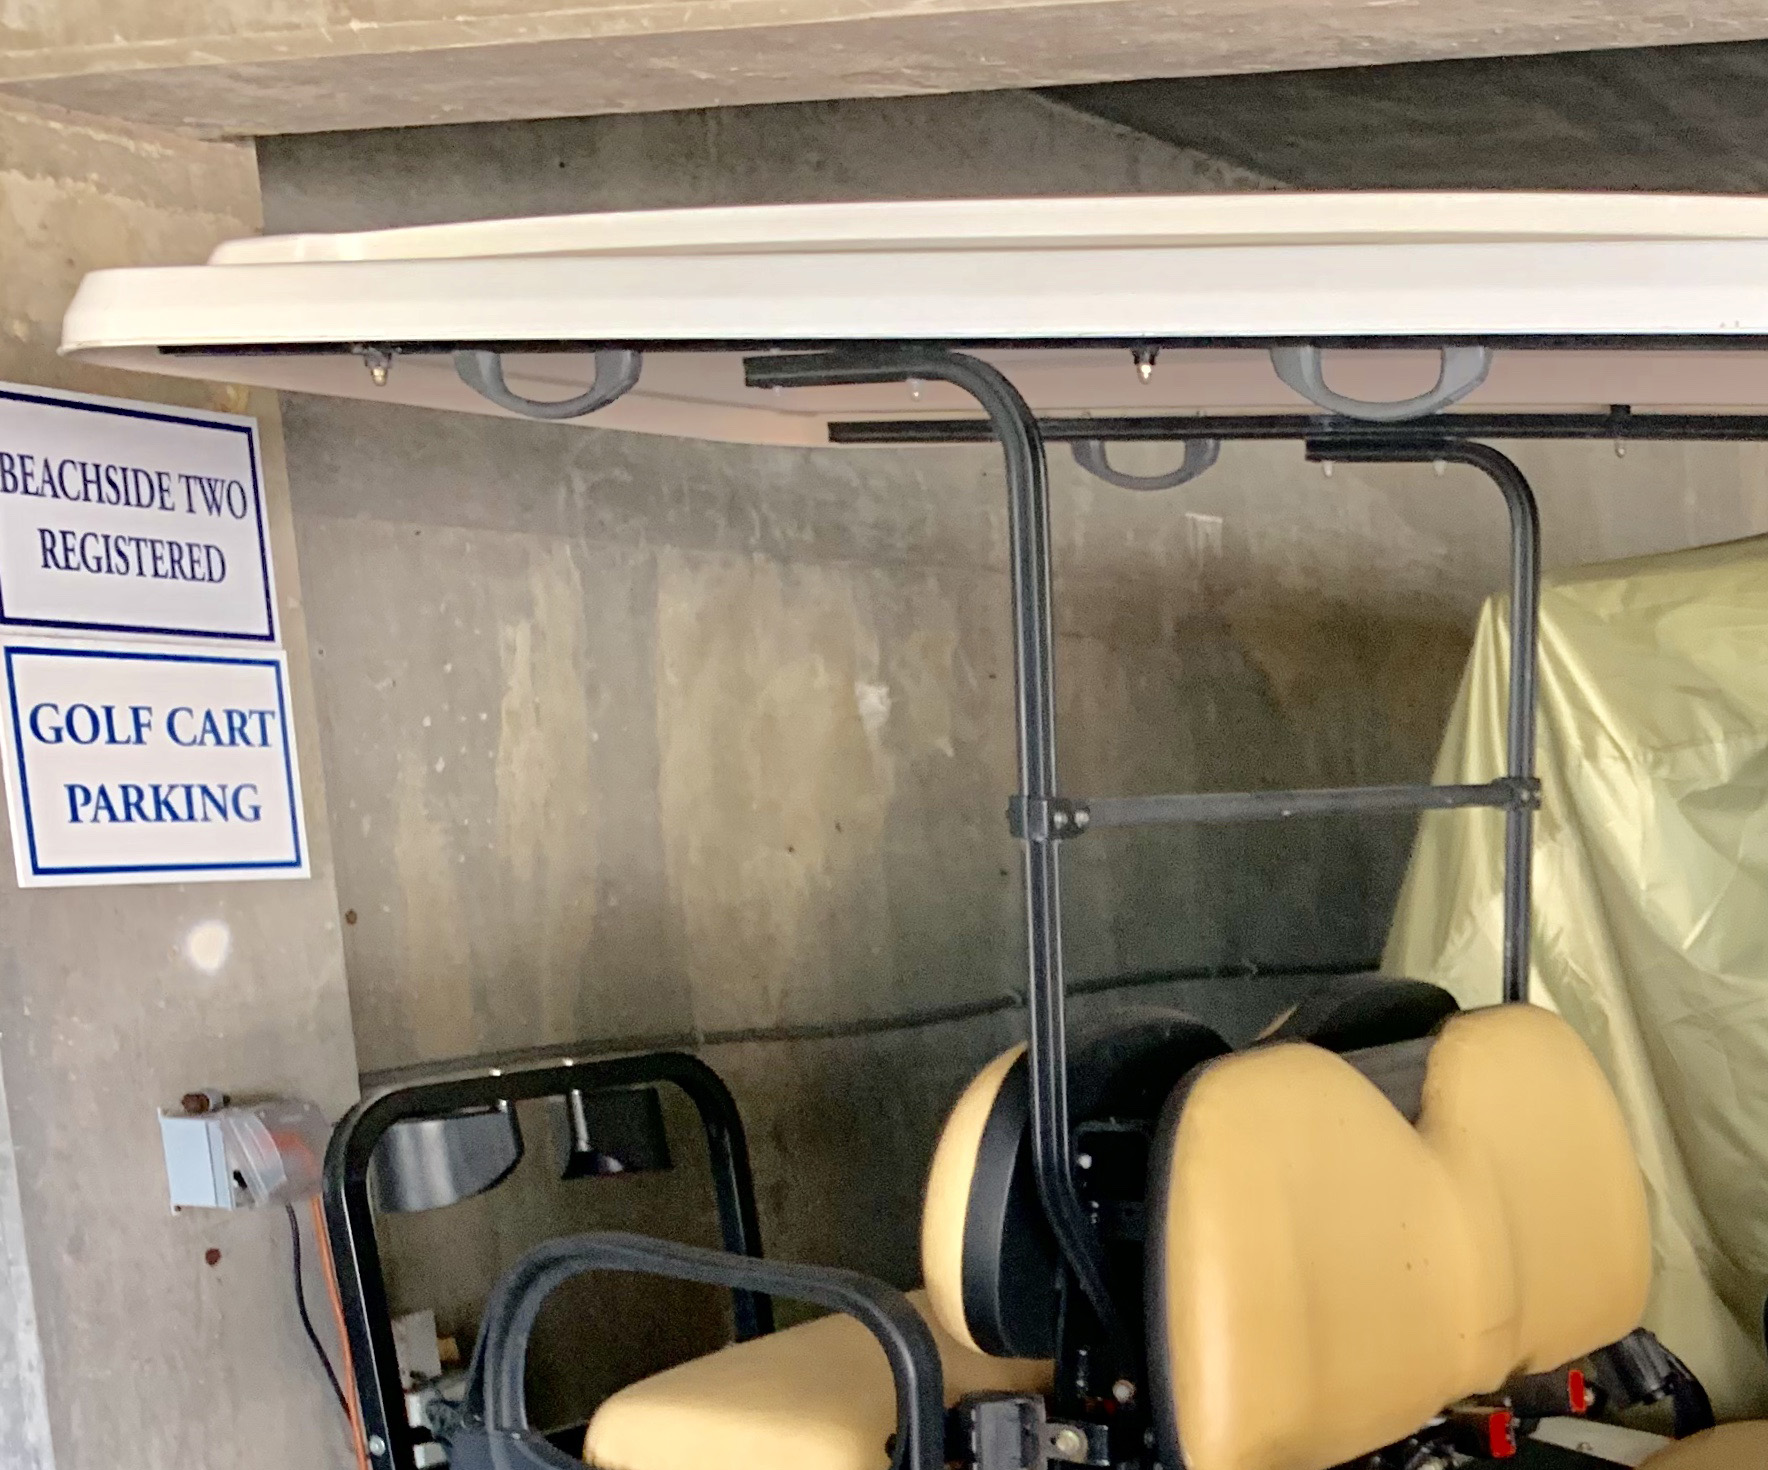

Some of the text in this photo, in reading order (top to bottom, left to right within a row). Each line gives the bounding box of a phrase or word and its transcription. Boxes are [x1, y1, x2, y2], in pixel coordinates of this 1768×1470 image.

[0, 451, 249, 519] BEACHSIDE TWO
[38, 528, 227, 584] REGISTERED
[29, 703, 275, 748] GOLF CART
[64, 783, 262, 824] PARKING
